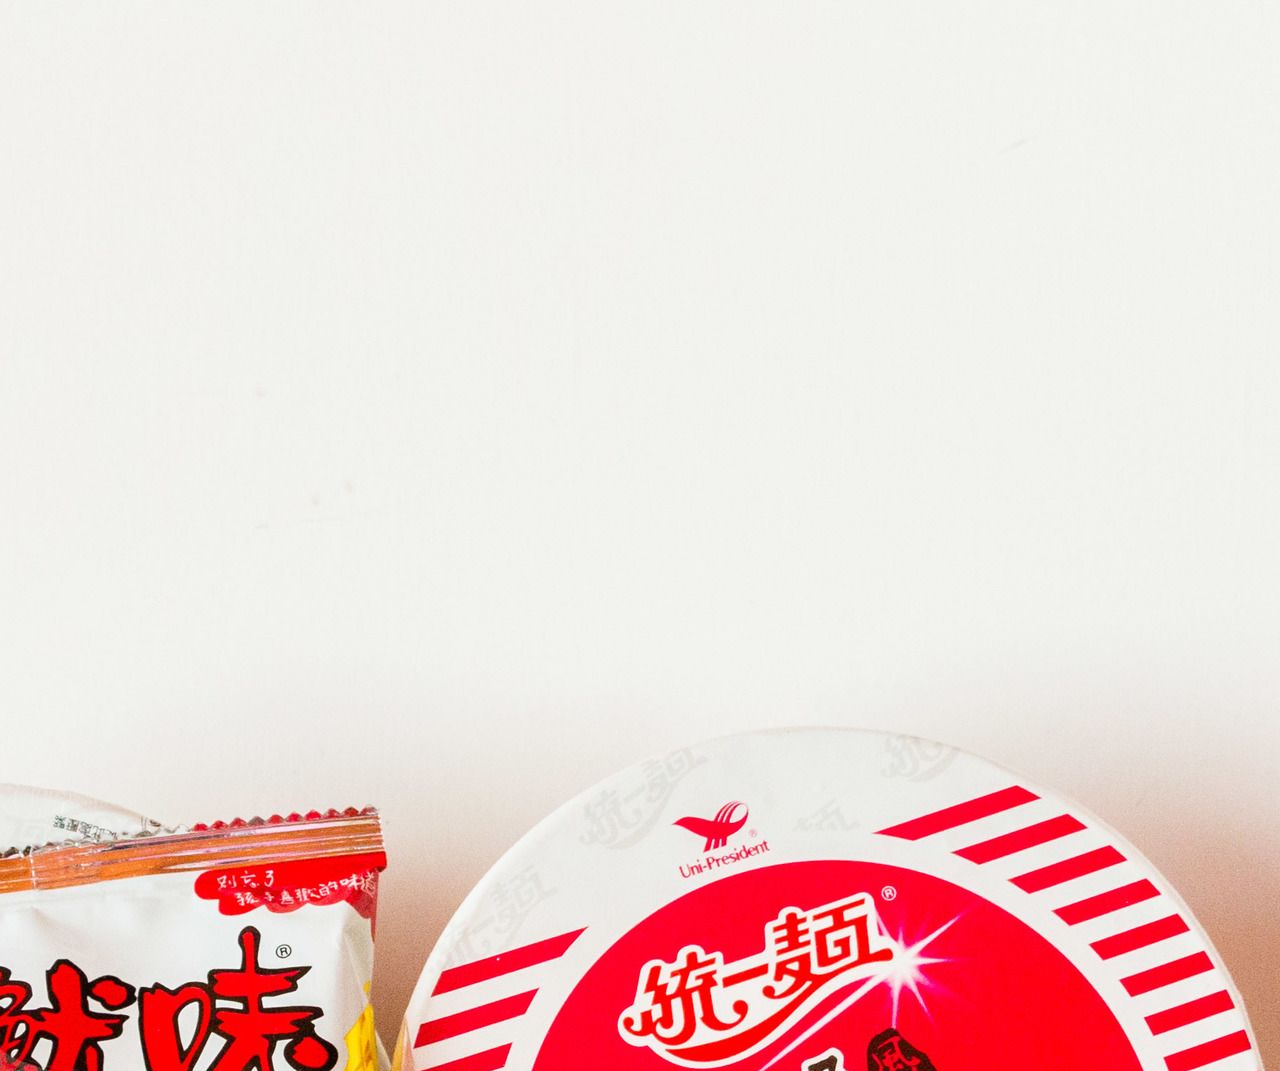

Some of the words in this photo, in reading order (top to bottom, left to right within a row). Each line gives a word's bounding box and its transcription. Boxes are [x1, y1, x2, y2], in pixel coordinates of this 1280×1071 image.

[678, 840, 771, 879] Uni-President
[620, 894, 896, 1058] 統一麵
